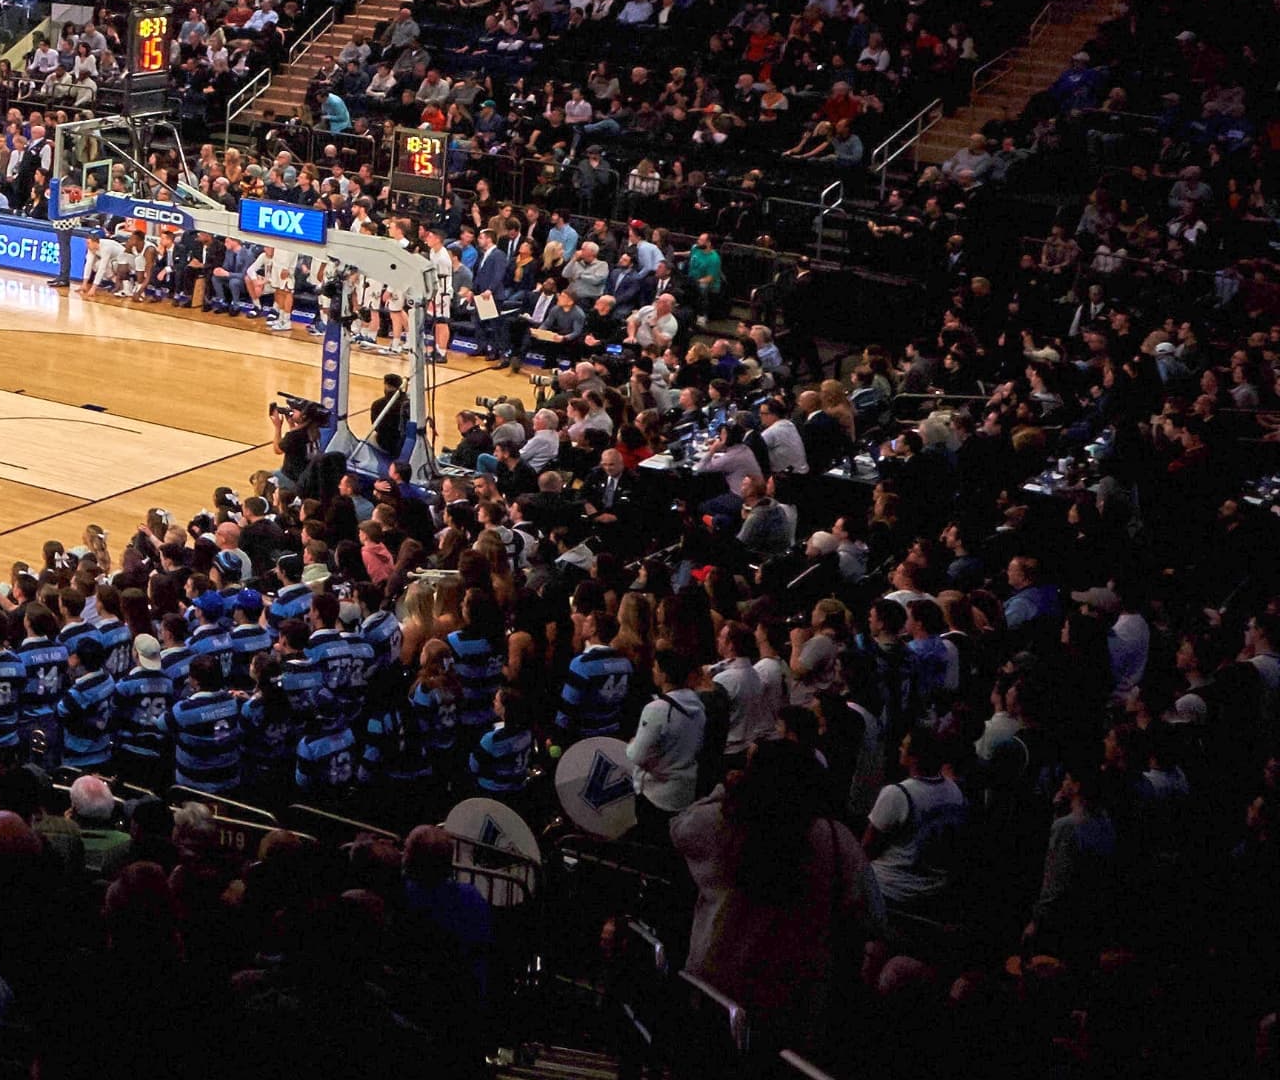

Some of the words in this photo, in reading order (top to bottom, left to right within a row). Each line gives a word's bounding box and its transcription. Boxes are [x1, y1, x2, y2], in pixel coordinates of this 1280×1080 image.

[138, 16, 168, 38] 18:37
[142, 37, 163, 71] 15
[406, 137, 441, 154] 18:37
[414, 152, 433, 176] 15
[133, 206, 184, 225] GEICO
[258, 206, 305, 236] FOX
